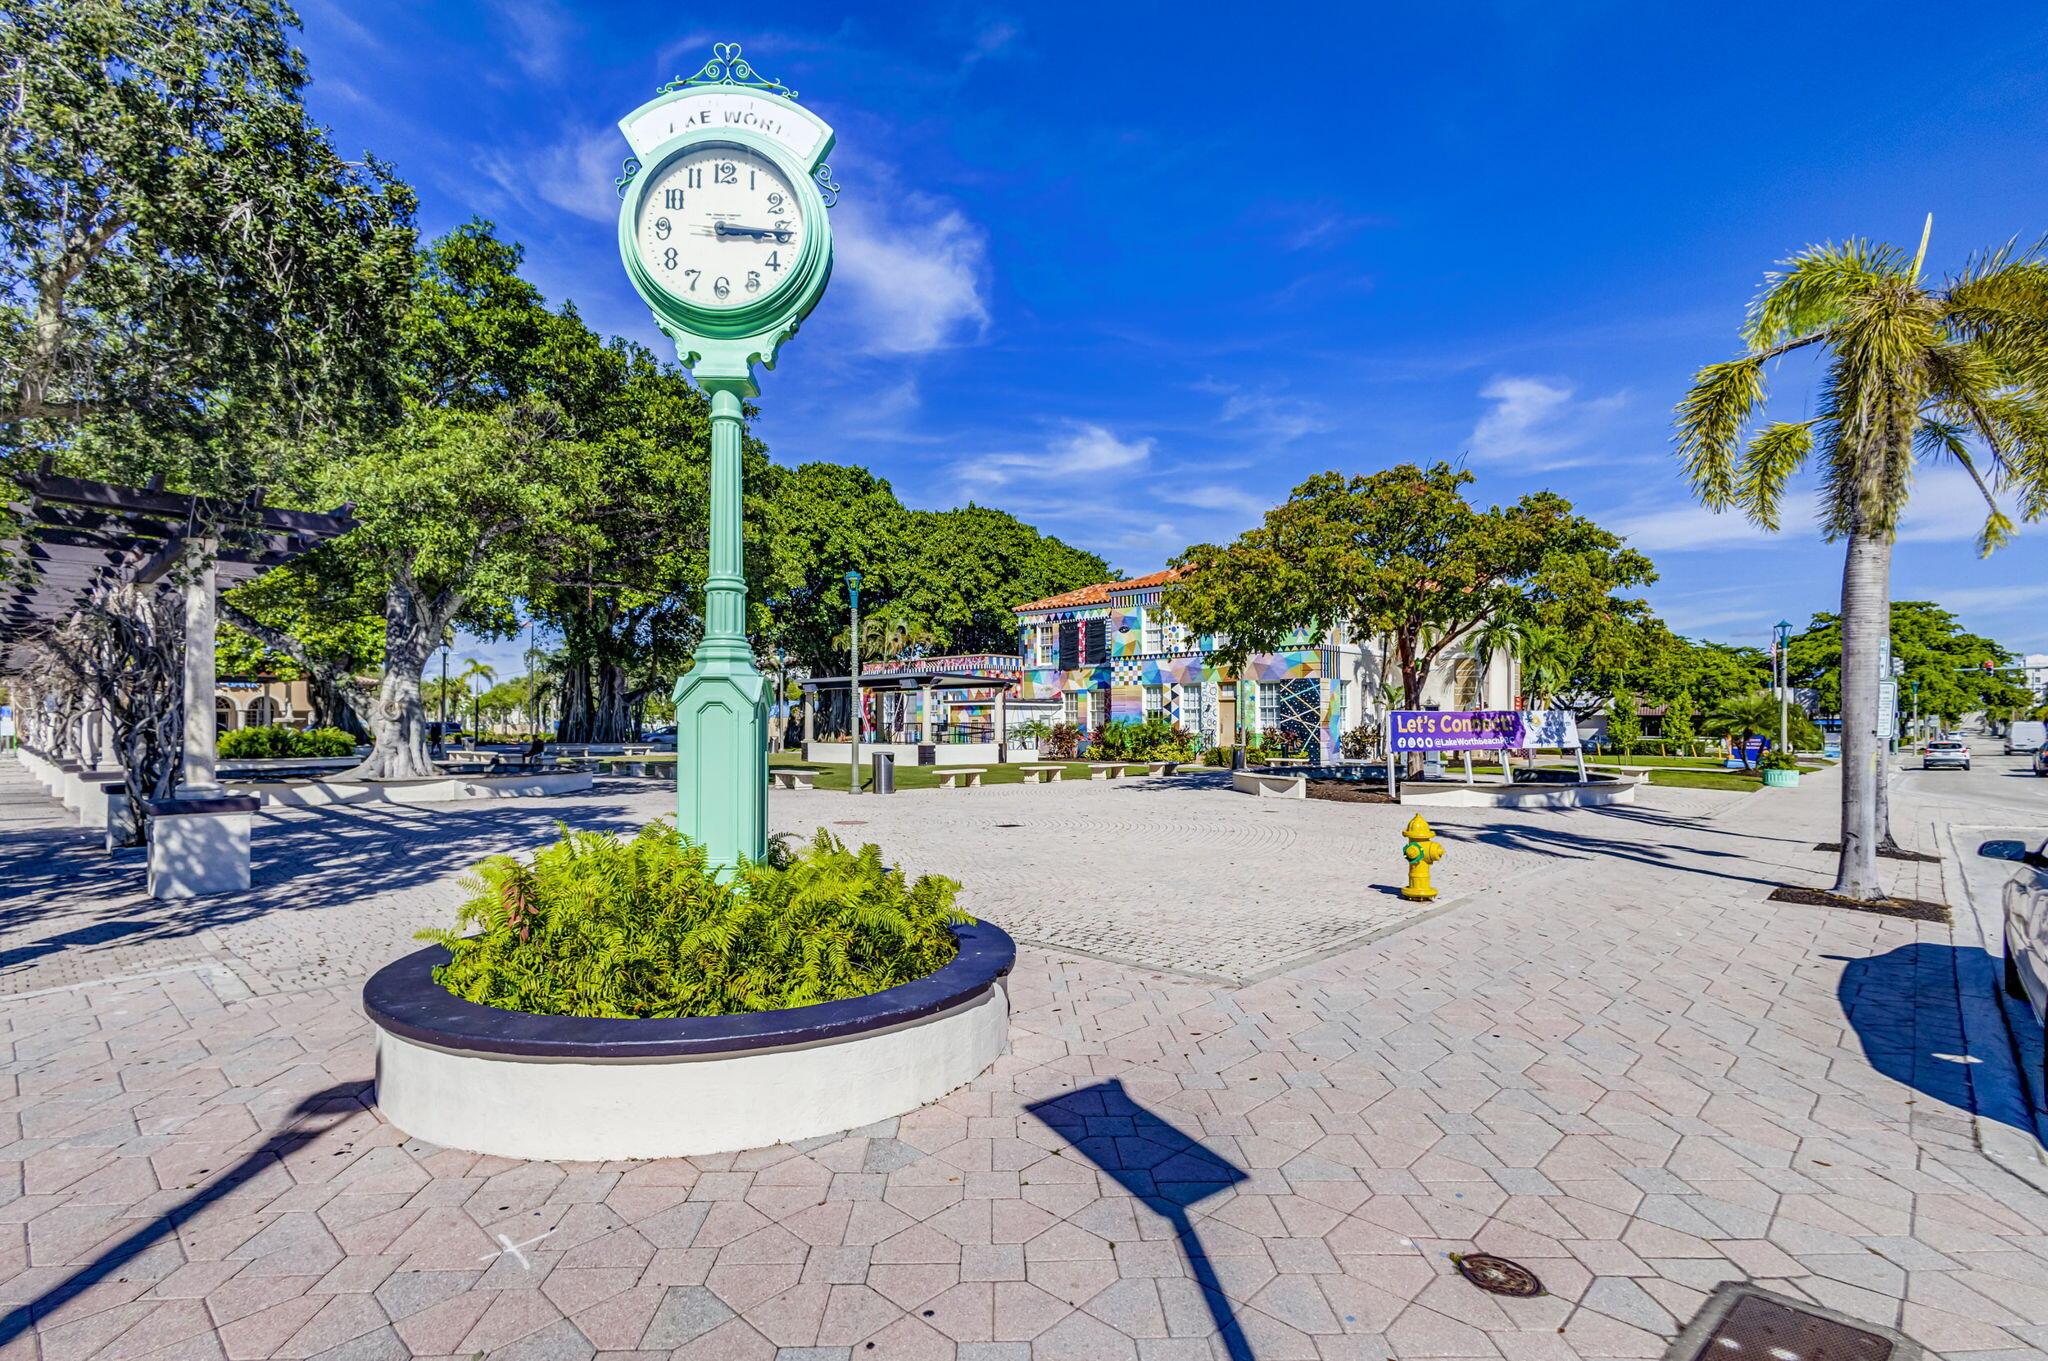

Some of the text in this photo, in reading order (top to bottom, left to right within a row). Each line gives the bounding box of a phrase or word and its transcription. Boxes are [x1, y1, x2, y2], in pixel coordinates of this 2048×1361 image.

[688, 168, 701, 189] 11
[714, 162, 737, 184] 12
[750, 170, 755, 191] 1
[665, 188, 684, 210] 10
[767, 192, 784, 214] 2
[655, 217, 672, 240] 9
[774, 220, 792, 243] 3
[664, 247, 679, 270] 8
[765, 251, 781, 271] 4
[685, 269, 701, 291] 7
[714, 277, 730, 299] 6
[745, 271, 760, 292] 5
[1397, 714, 1436, 733] Let's
